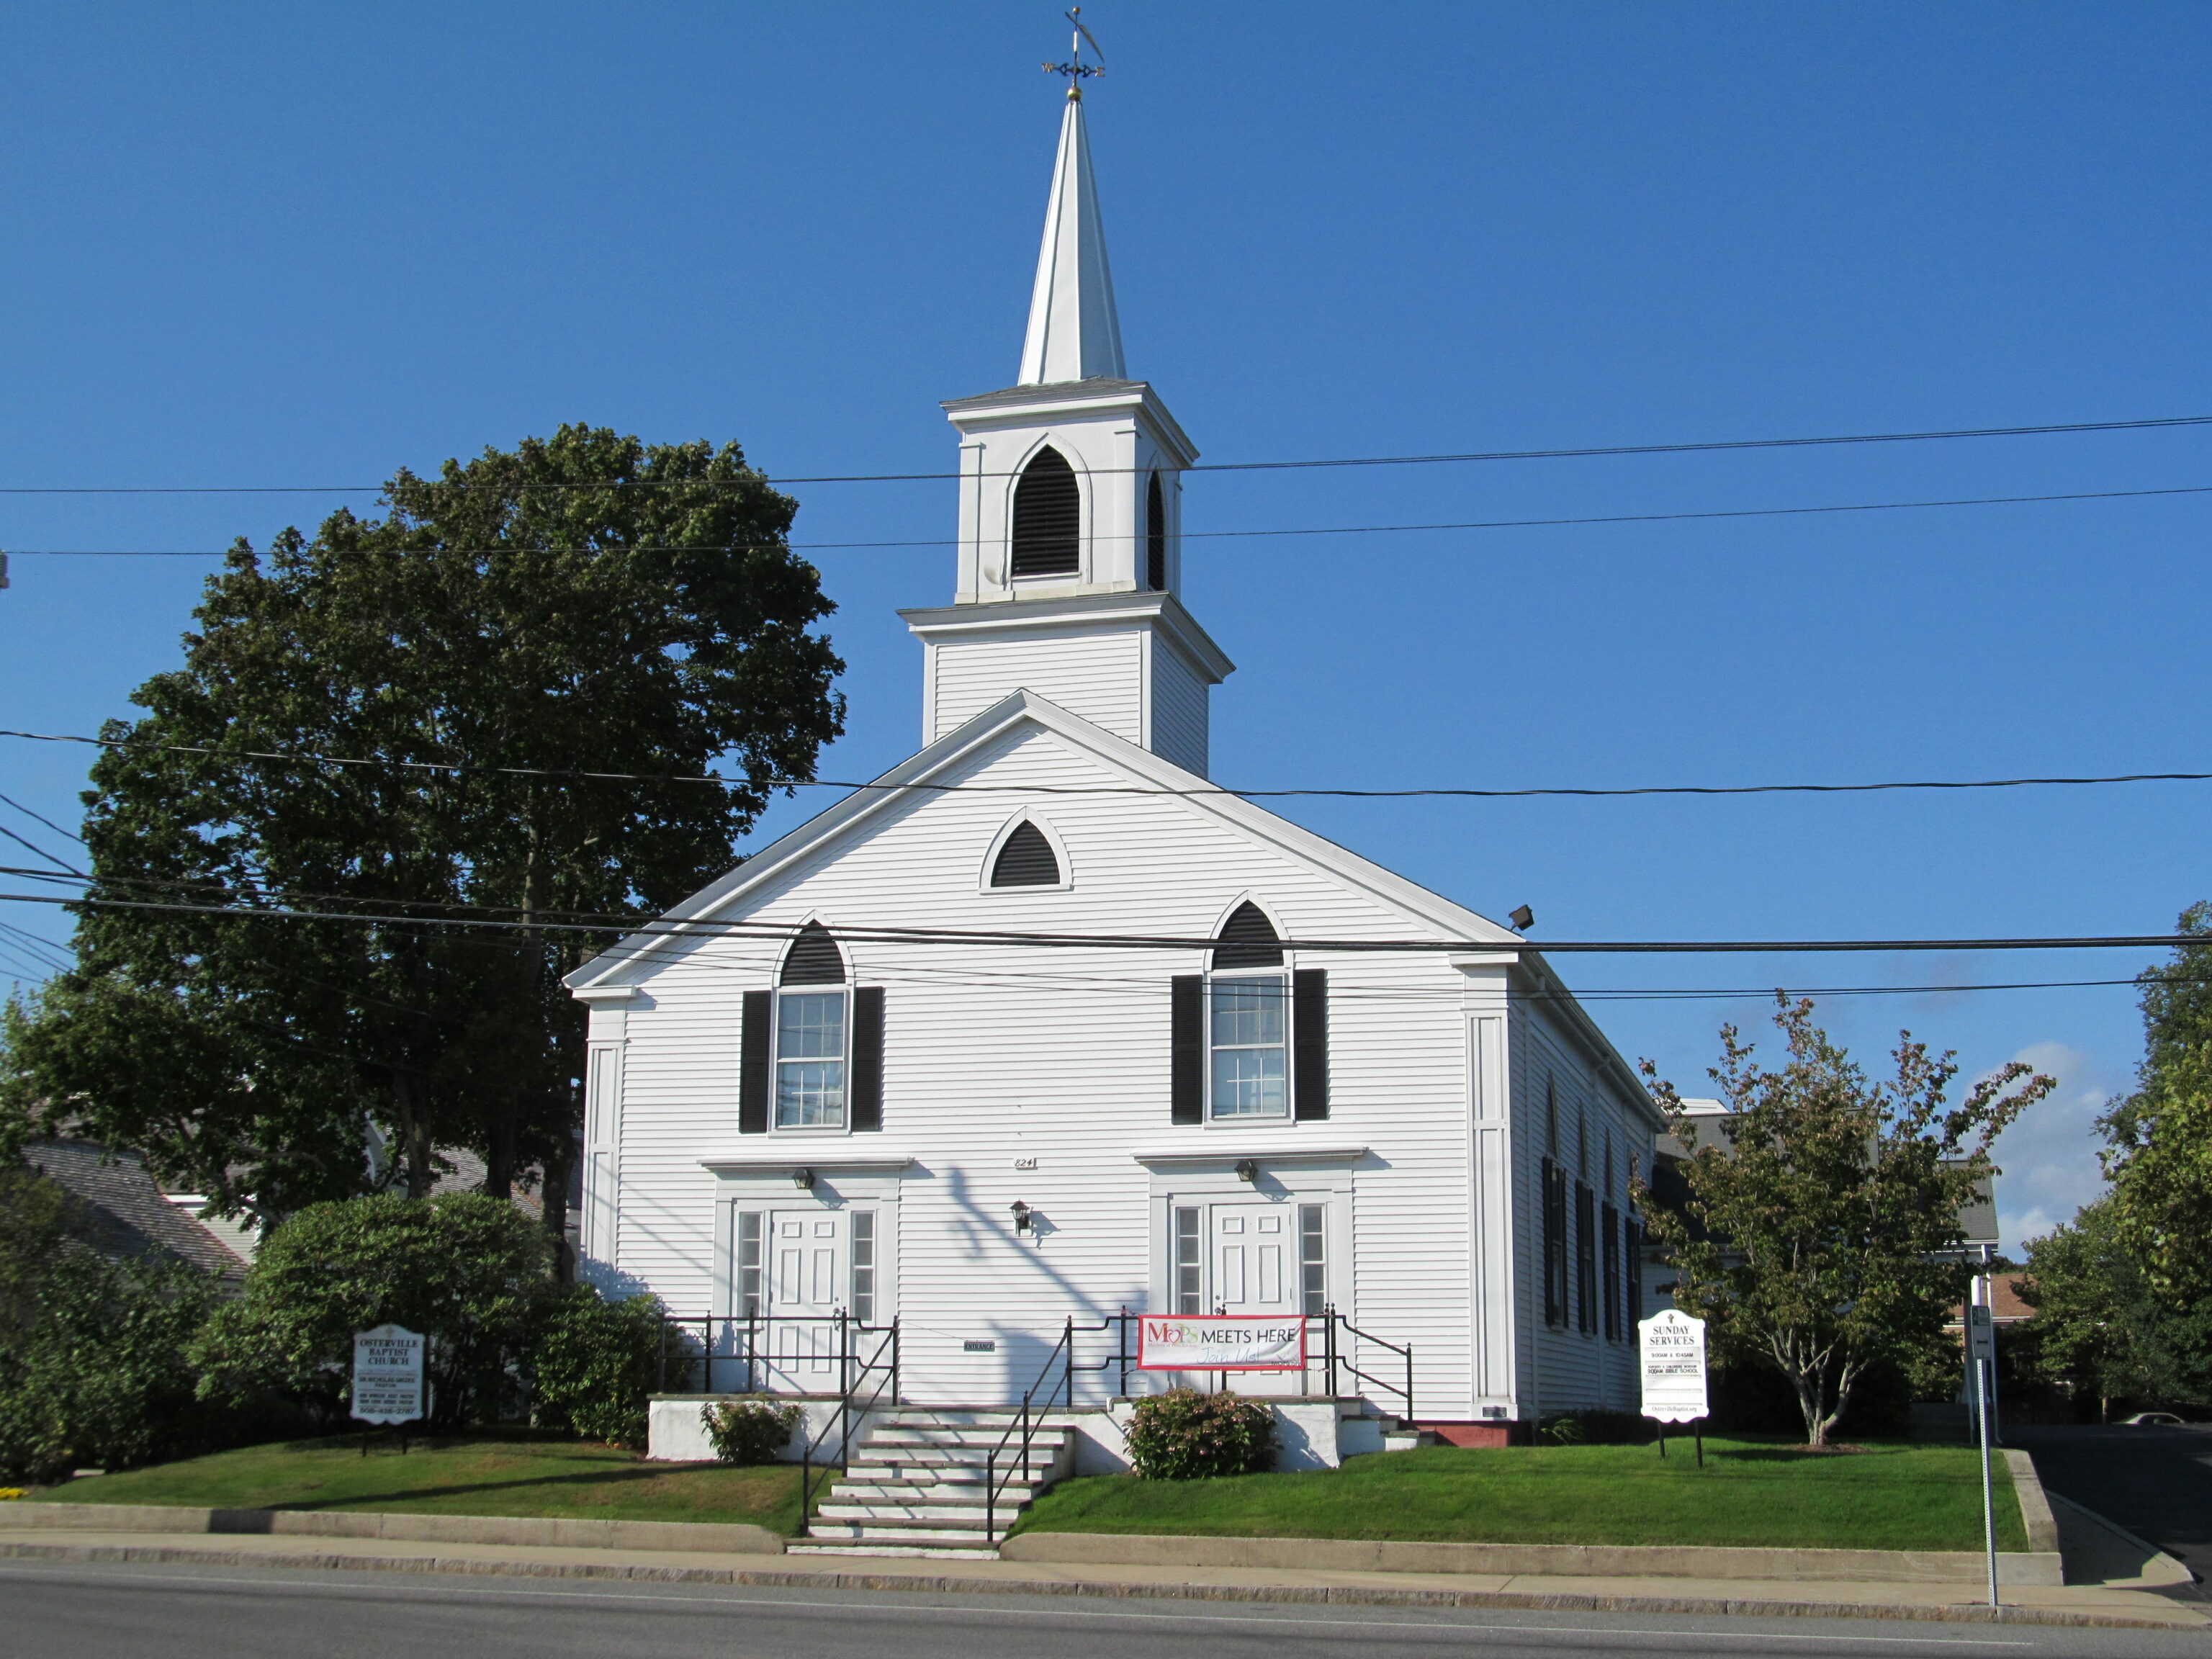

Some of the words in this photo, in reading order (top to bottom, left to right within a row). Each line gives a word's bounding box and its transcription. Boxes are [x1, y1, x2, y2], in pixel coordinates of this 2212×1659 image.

[1653, 1326, 1690, 1334] SUNDAY
[1201, 1329, 1251, 1343] MEETS
[1257, 1328, 1295, 1343] HERE
[360, 1339, 418, 1348] OSTERVILLE
[1650, 1336, 1694, 1345] SERVICES
[1197, 1347, 1228, 1364] Join
